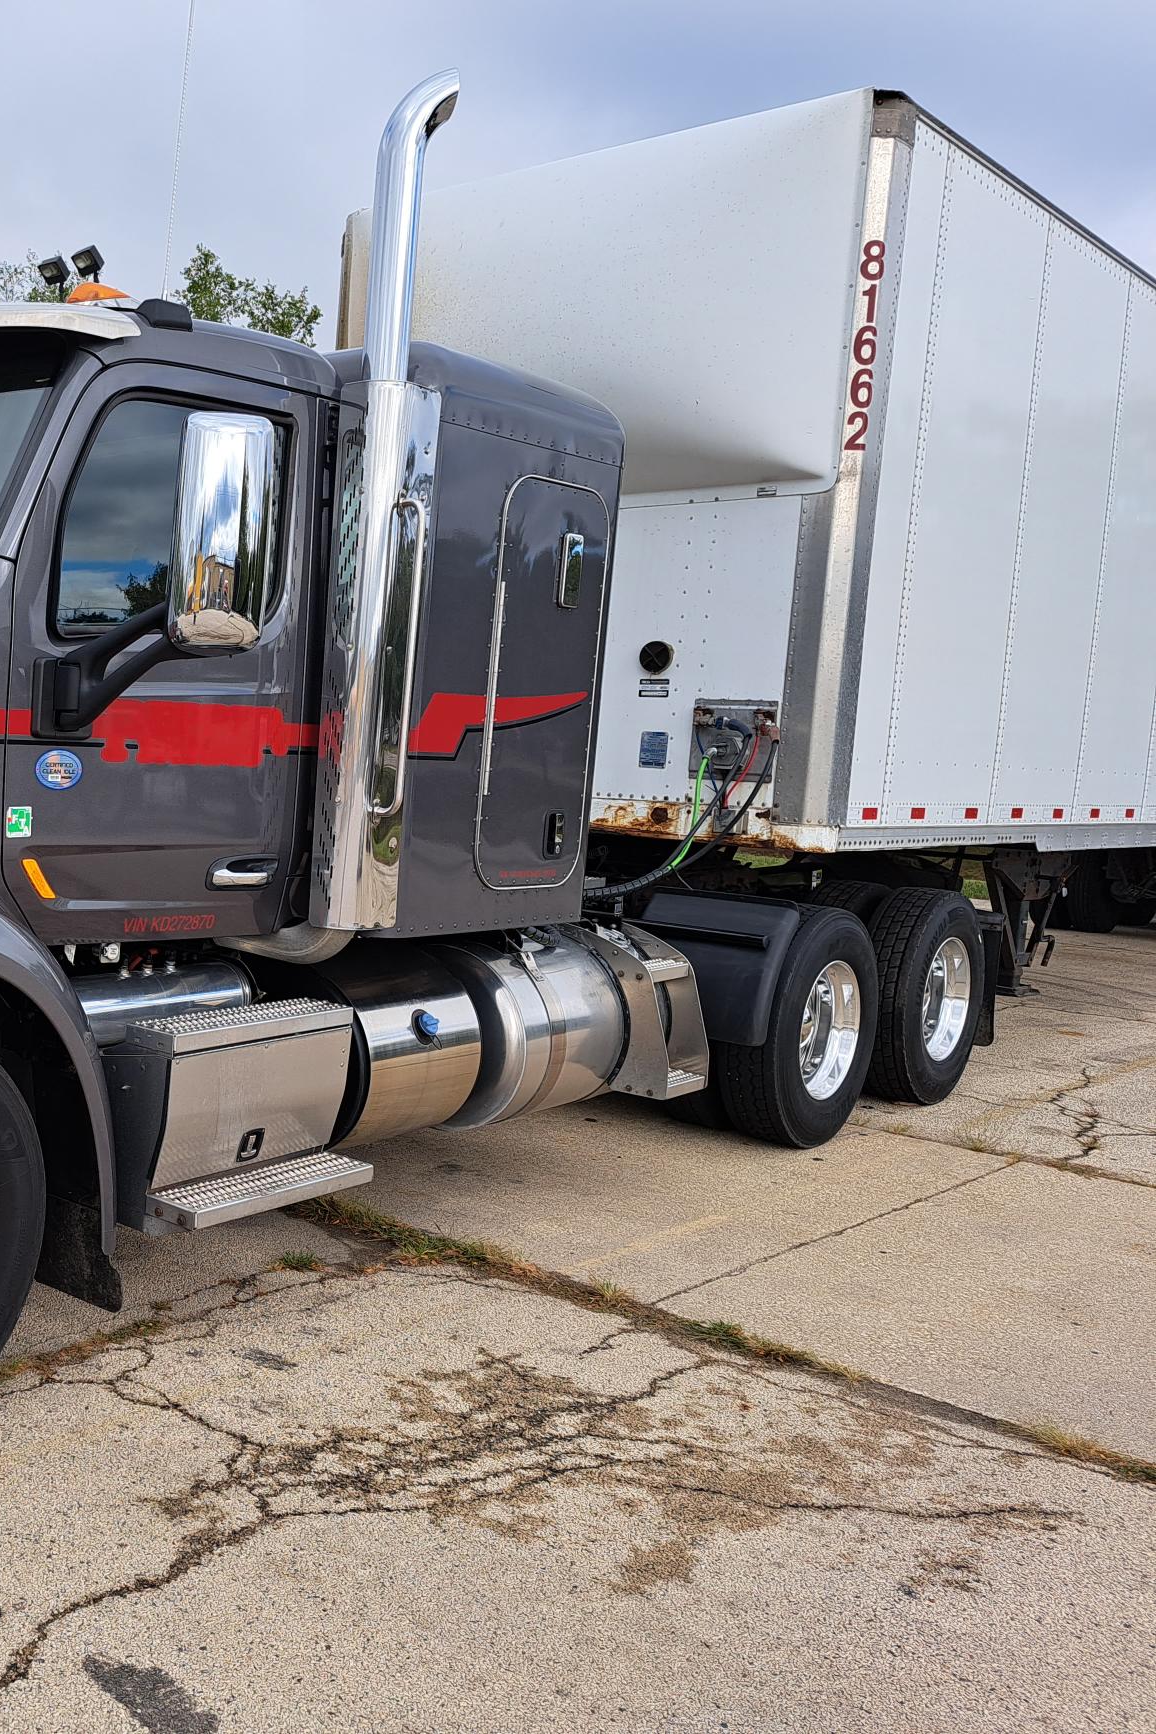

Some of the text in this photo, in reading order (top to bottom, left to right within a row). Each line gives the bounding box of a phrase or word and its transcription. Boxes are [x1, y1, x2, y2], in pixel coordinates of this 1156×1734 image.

[844, 240, 886, 451] 81662
[124, 914, 216, 932] VIN KD272870
